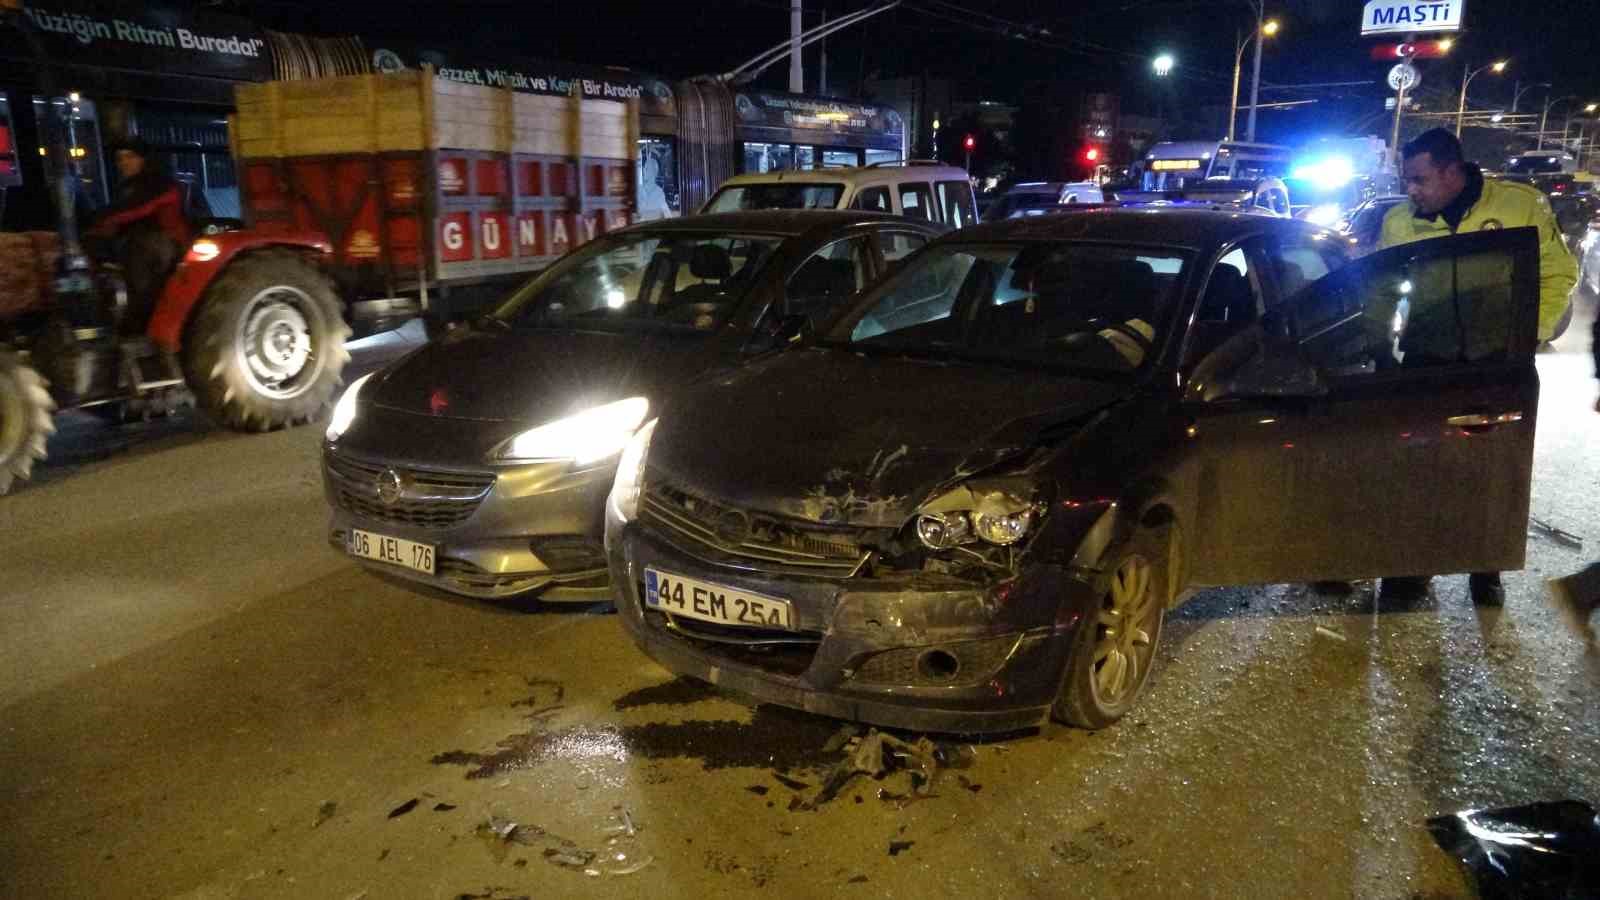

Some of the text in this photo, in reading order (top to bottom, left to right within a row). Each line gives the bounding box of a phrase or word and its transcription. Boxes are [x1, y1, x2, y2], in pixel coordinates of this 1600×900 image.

[113, 19, 175, 48] Ritmi
[529, 76, 548, 90] ve
[582, 79, 601, 96] Bir
[443, 217, 598, 250] GÜNAY
[354, 532, 432, 570] 06 AEL 176
[659, 578, 686, 609] 44
[693, 587, 728, 620] EM
[735, 598, 781, 626] 254
